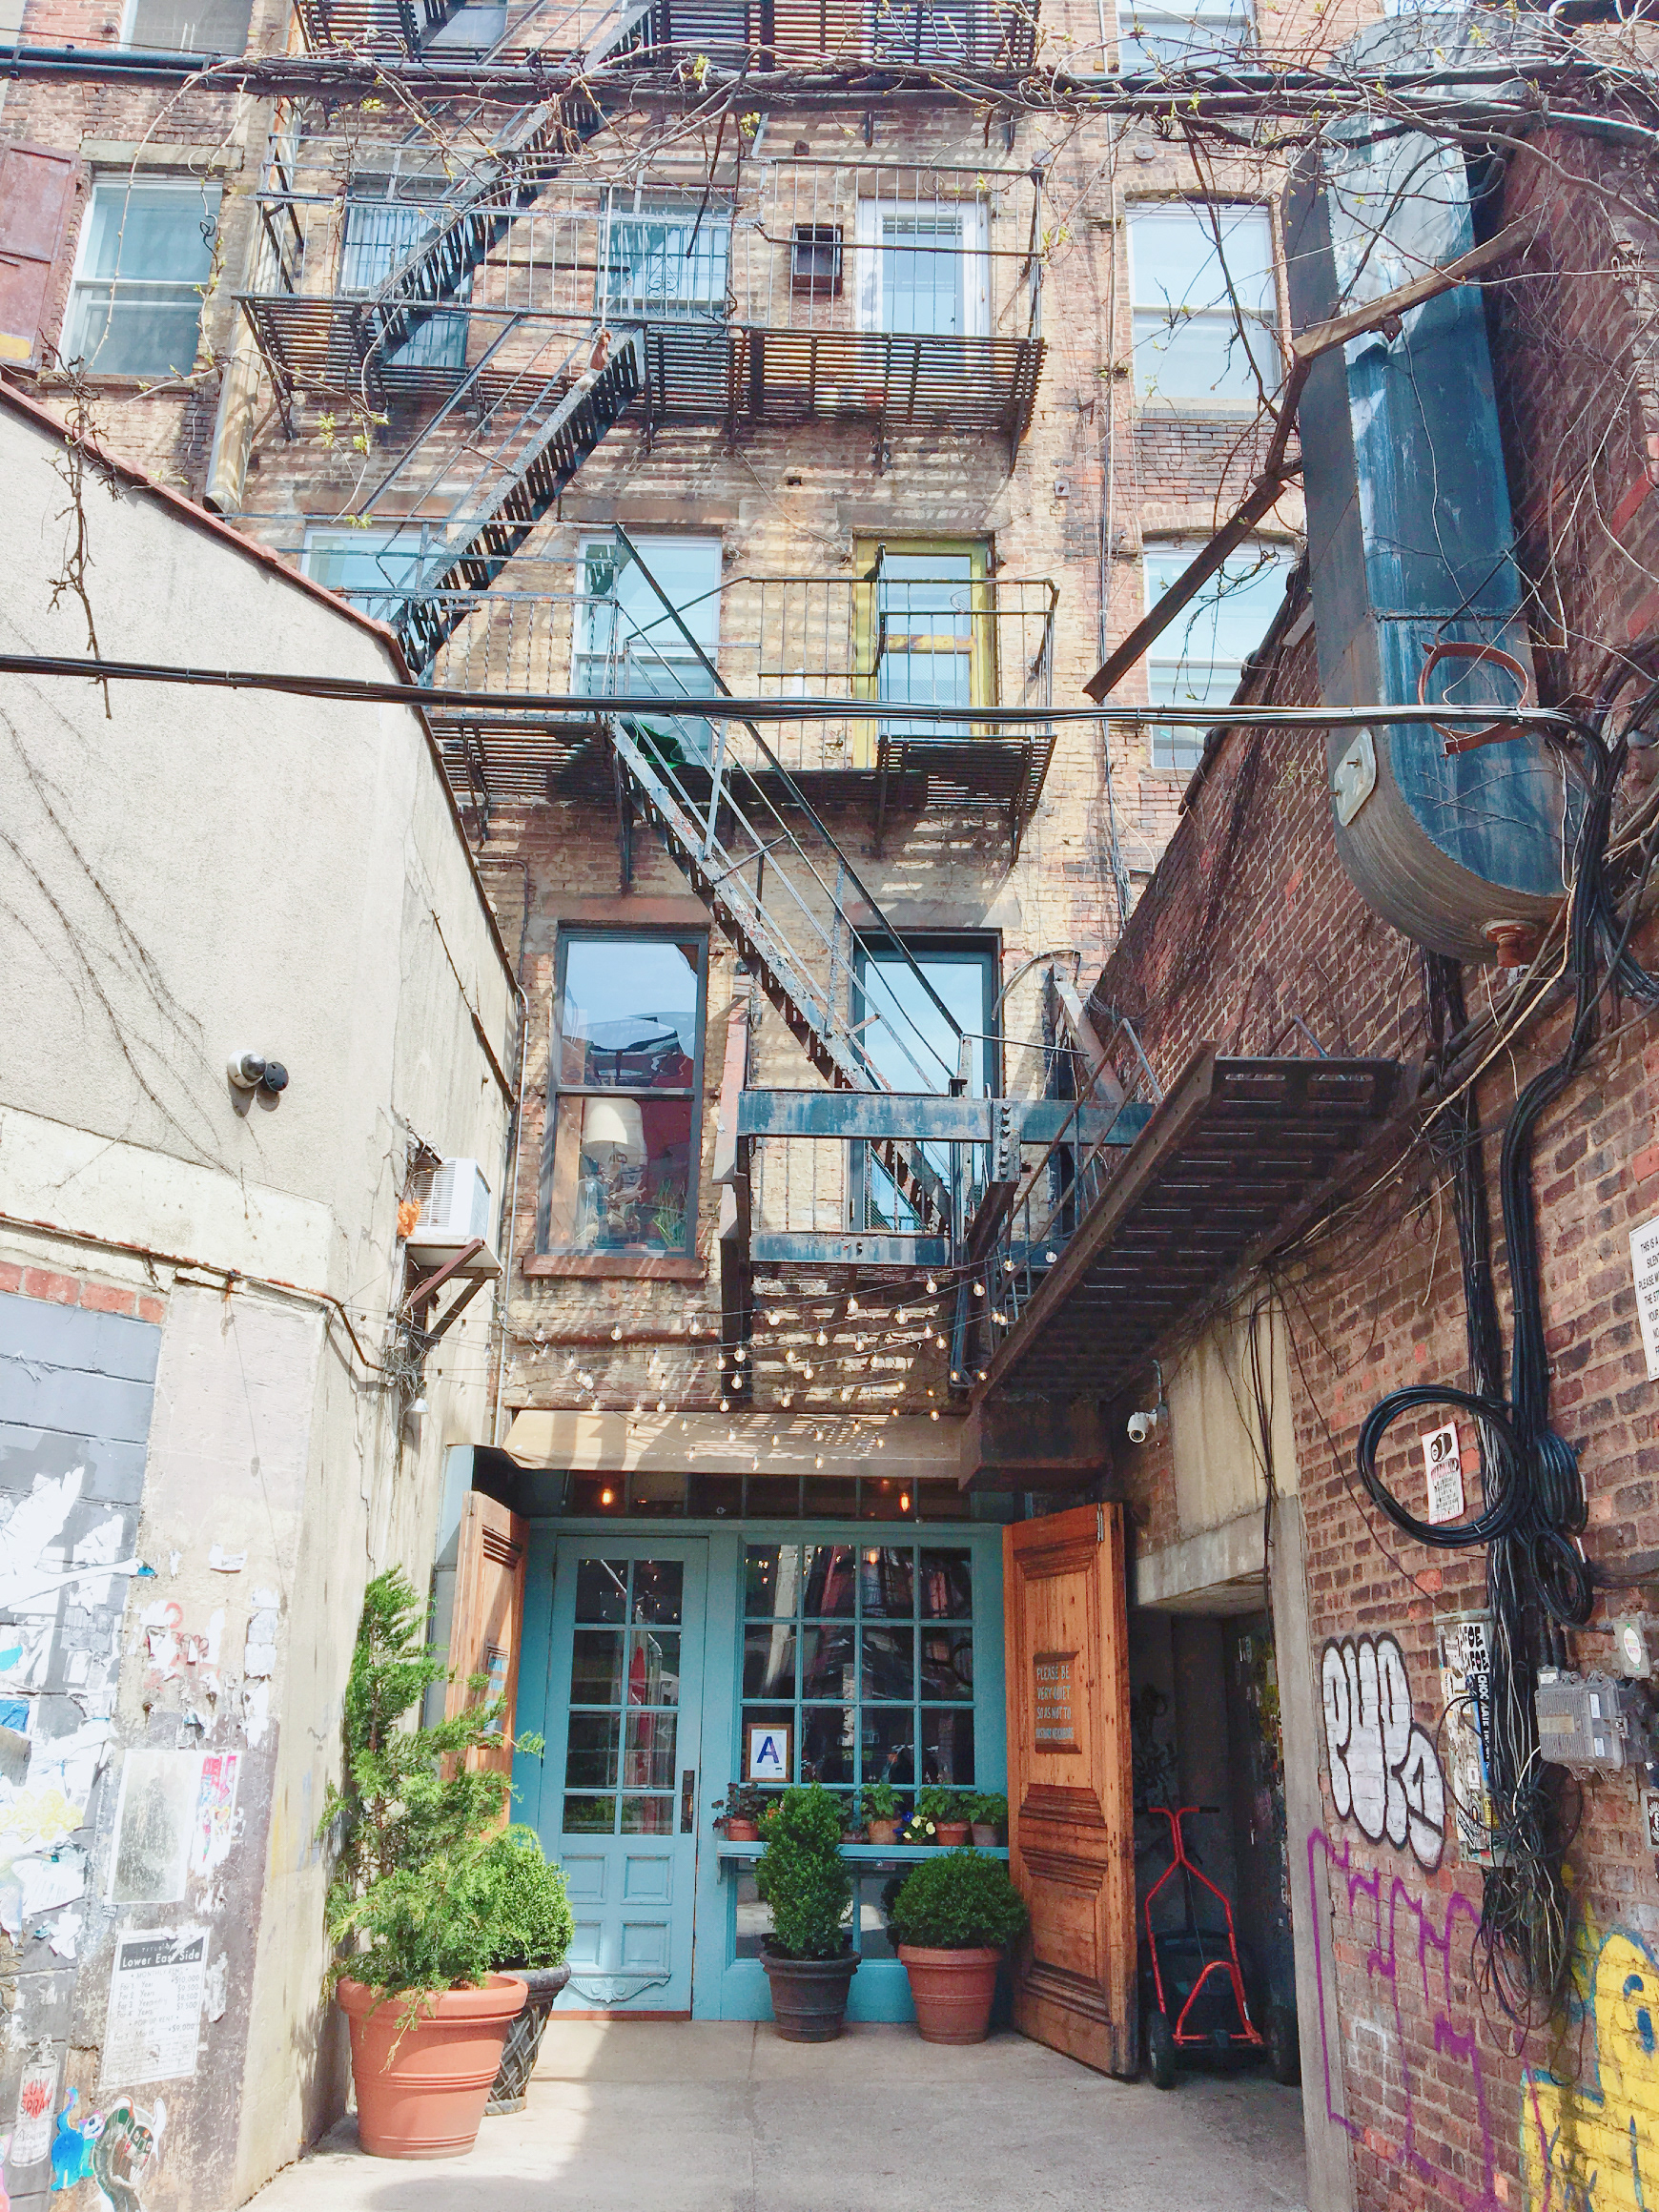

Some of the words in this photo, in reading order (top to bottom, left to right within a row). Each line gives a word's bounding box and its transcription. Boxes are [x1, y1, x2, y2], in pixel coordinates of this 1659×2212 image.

[1640, 1240, 1649, 1254] THIS
[1649, 1238, 1654, 1249] IS
[1638, 1274, 1654, 1291] PLEASE
[1644, 1293, 1653, 1305] THE
[1036, 1666, 1059, 1681] PLEASE
[1061, 1665, 1070, 1679] BE
[1037, 1686, 1053, 1700] VERY
[1054, 1685, 1071, 1700] QUIET
[1037, 1707, 1044, 1719] SO
[1052, 1706, 1062, 1719] NOT
[1063, 1706, 1071, 1719] TO
[756, 1736, 780, 1763] A
[122, 1956, 152, 1968] Lower
[178, 1949, 200, 1961] Side
[19, 2096, 52, 2117] SPRAY
